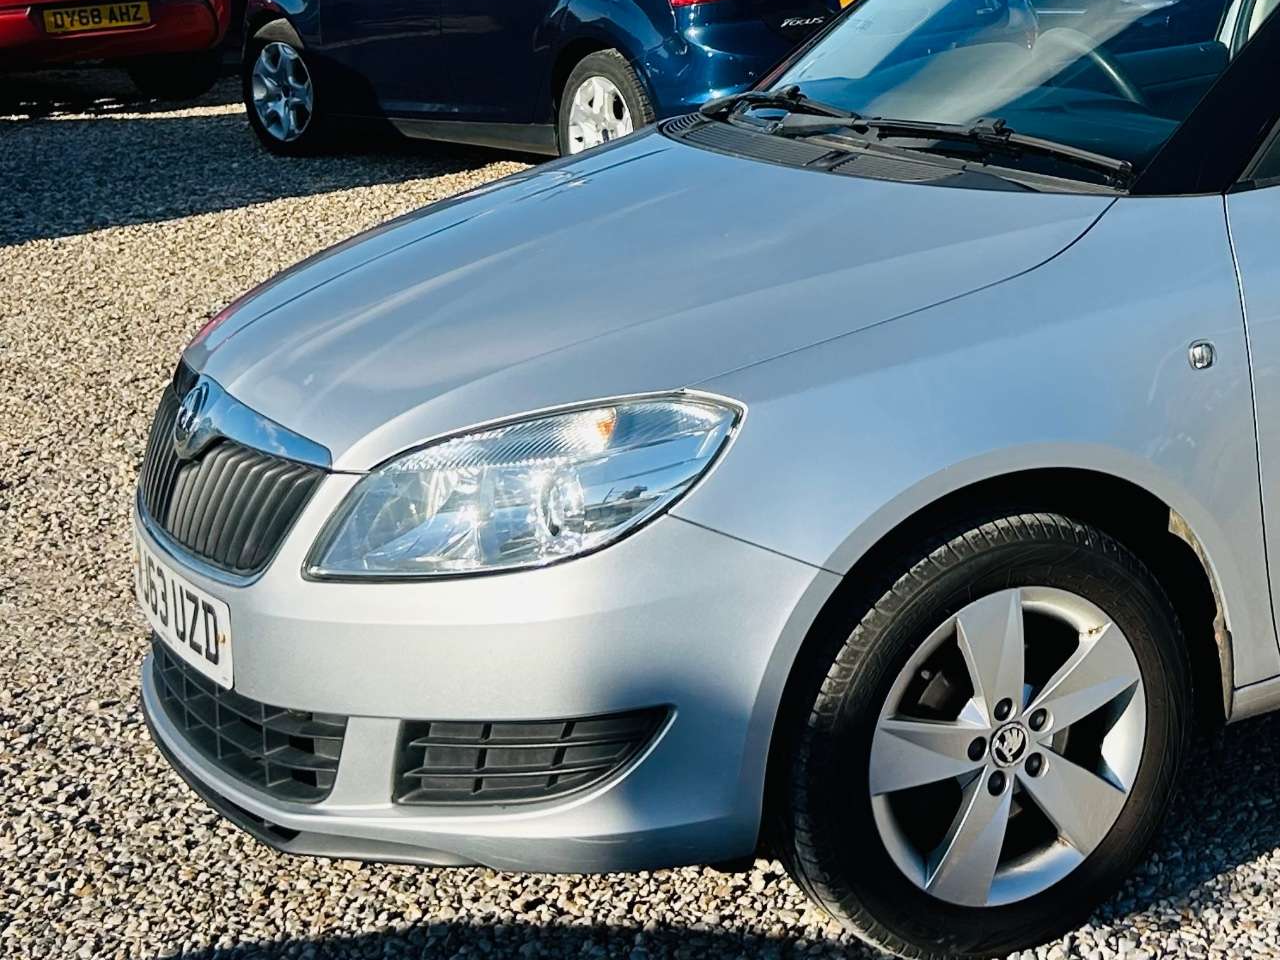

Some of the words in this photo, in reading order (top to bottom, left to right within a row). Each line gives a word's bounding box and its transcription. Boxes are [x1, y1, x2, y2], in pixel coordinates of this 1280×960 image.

[52, 7, 102, 29] DY68
[108, 4, 144, 24] AHZ
[171, 578, 219, 666] UZD
